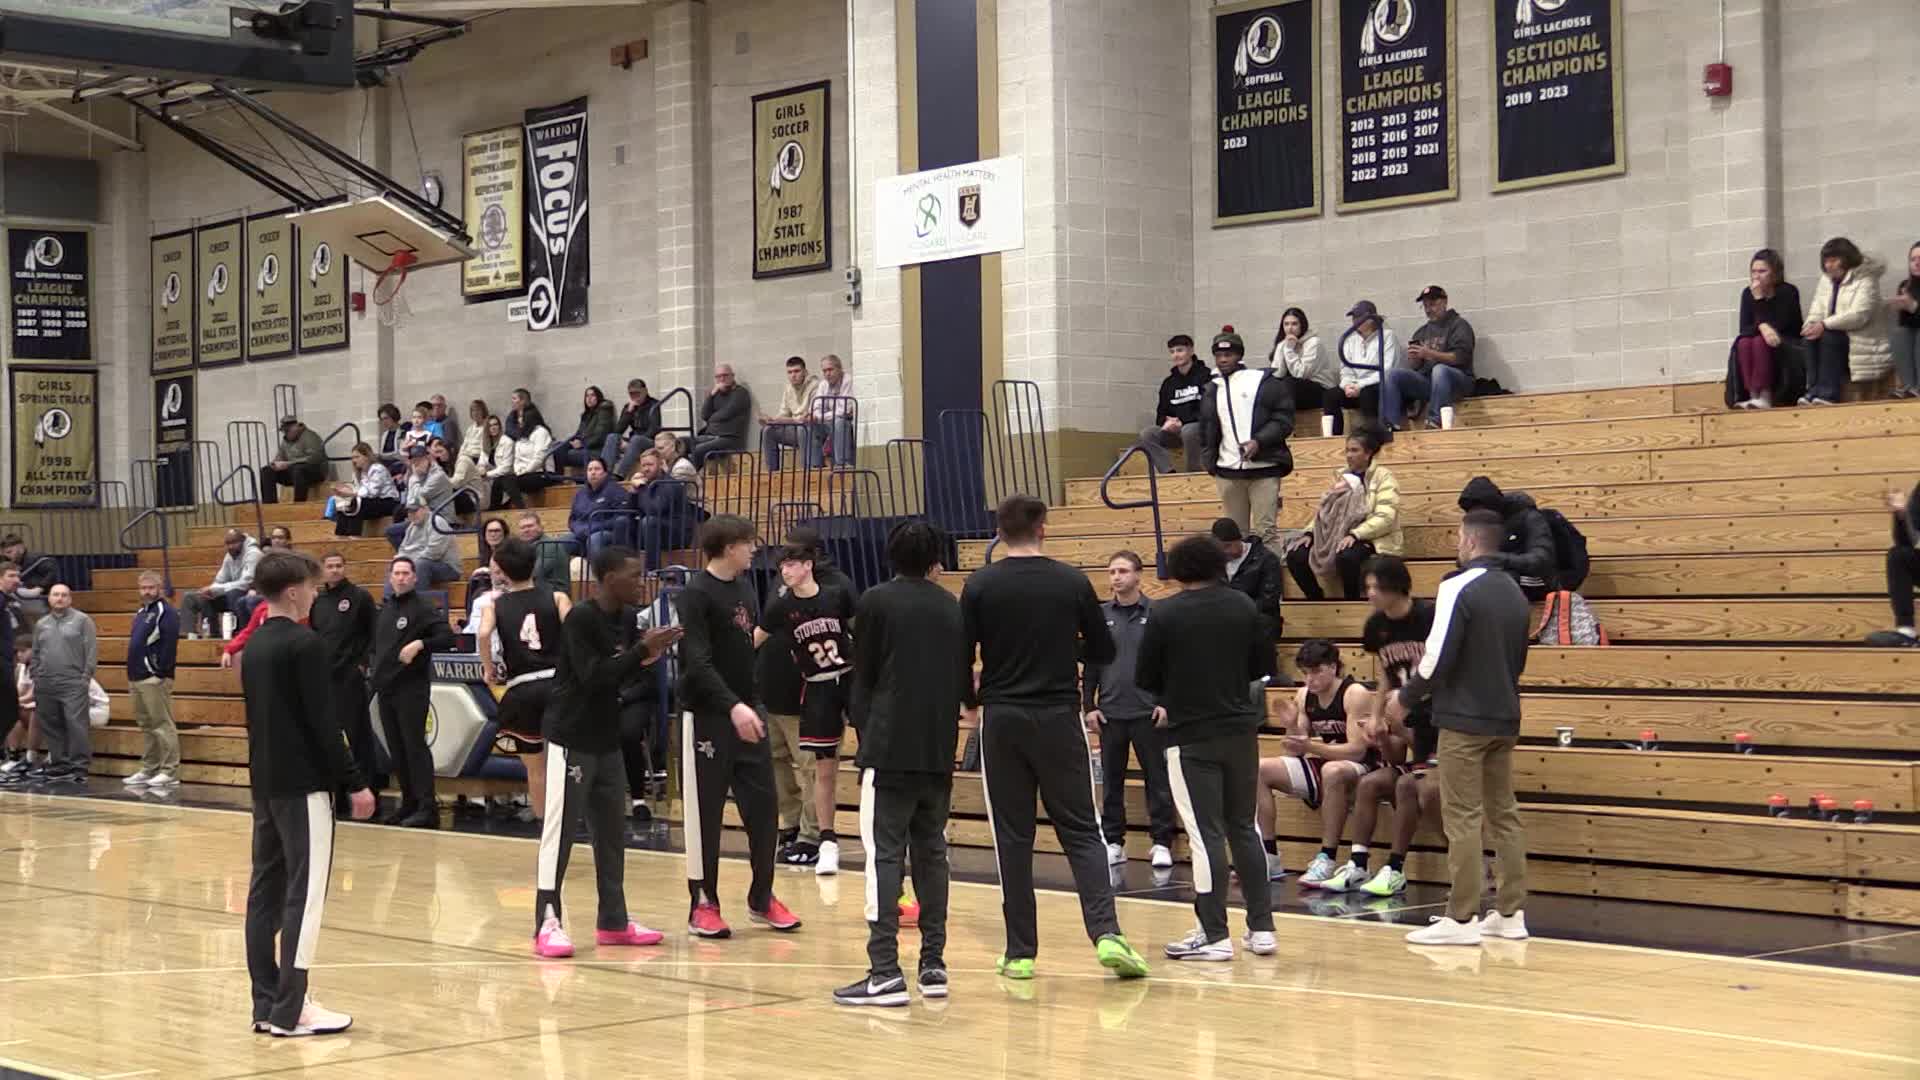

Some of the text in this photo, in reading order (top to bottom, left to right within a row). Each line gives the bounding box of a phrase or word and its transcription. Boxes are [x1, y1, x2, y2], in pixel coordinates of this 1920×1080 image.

[1513, 15, 1592, 39] GIRLS LACROSSE
[1358, 47, 1428, 68] GIRLS LACROSSE
[1506, 32, 1601, 66] SECTIONAL
[1245, 72, 1284, 86] SOFTBALL
[1363, 65, 1425, 91] LEAGUE
[1502, 52, 1607, 87] CHAMPIONS
[1237, 88, 1292, 110] LEAGUE
[1345, 82, 1442, 114] CHAMPIONS
[1505, 85, 1568, 108] 2019 2023
[775, 103, 806, 121] GIRLS
[1221, 104, 1308, 132] CHAMPIONS
[1350, 107, 1439, 133] 2012 2013 2014
[535, 123, 578, 141] WARRIOR
[771, 120, 809, 140] SOCCER
[1351, 123, 1439, 149] 2015 2016 2017
[1223, 136, 1248, 150] 2023
[1351, 142, 1439, 165] 2018 2019 2021
[1351, 163, 1408, 182] 2022 2023
[536, 140, 578, 256] FOCUS
[777, 204, 803, 220] 1987
[773, 223, 806, 240] STATE
[758, 240, 822, 262] CHAMPIONS
[27, 282, 73, 294] LEAGUE
[14, 294, 87, 306] CHAMPIONS
[38, 381, 72, 391] GIRLS
[25, 471, 88, 481] ALL-STATE
[20, 485, 93, 497] CHAMPIONS
[519, 613, 542, 650] 4
[808, 639, 846, 668] 22
